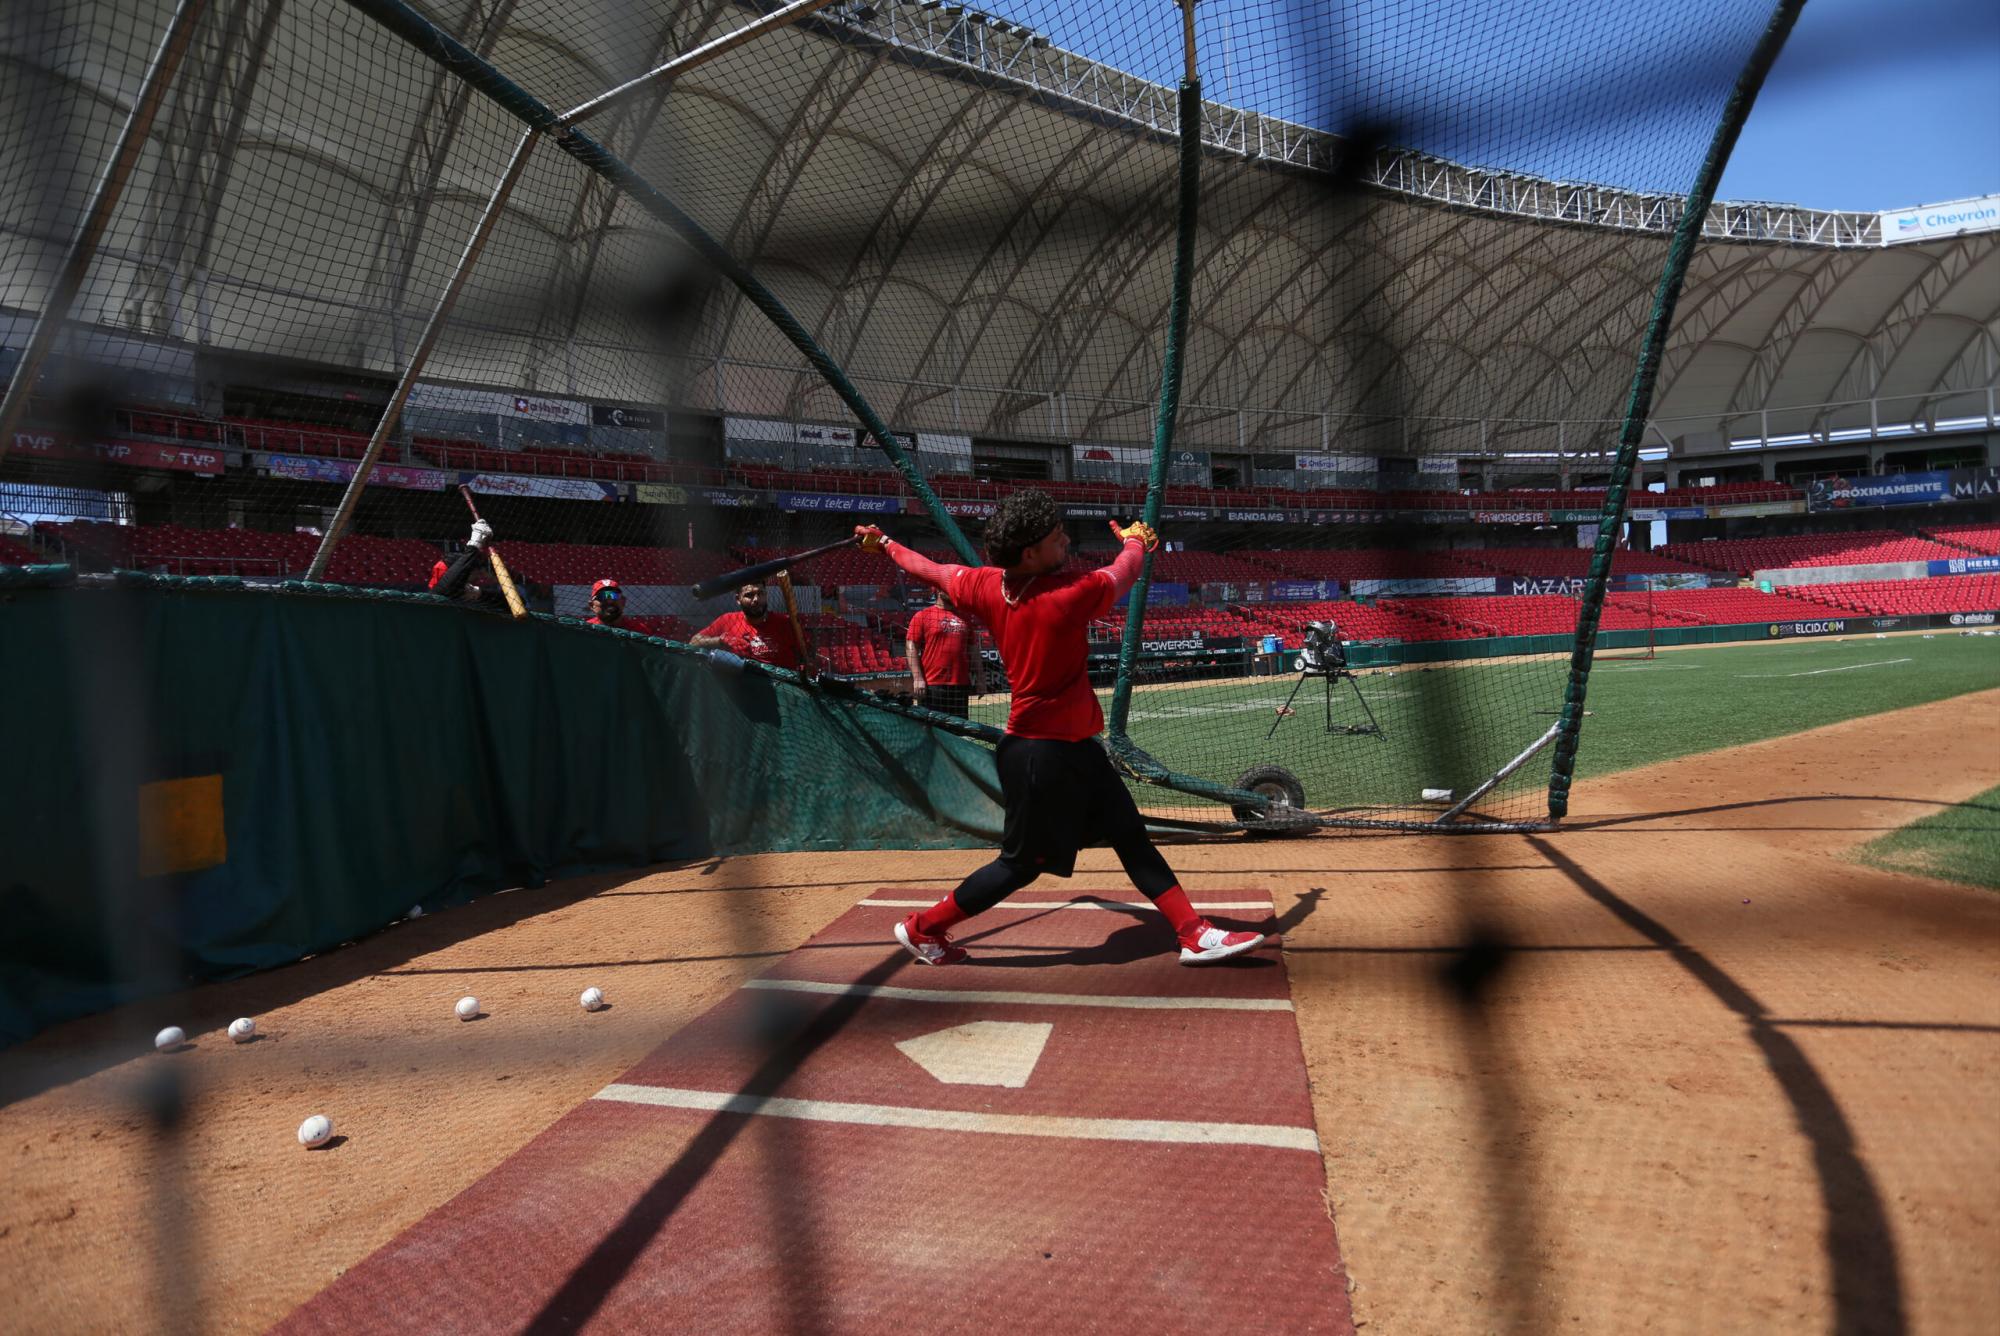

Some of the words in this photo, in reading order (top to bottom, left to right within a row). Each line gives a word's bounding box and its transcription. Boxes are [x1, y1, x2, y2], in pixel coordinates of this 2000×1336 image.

[1926, 208, 1996, 227] Chevron
[179, 452, 216, 467] TVP
[1832, 481, 1942, 499] PRÓXIMAMENTE
[1954, 479, 2000, 496] MA
[791, 496, 819, 508] telcel
[824, 498, 852, 509] telcel
[858, 500, 886, 511] telcel
[961, 504, 981, 514] 97.9
[1228, 511, 1284, 522] BANDAMS
[1142, 639, 1204, 651] POWERADE
